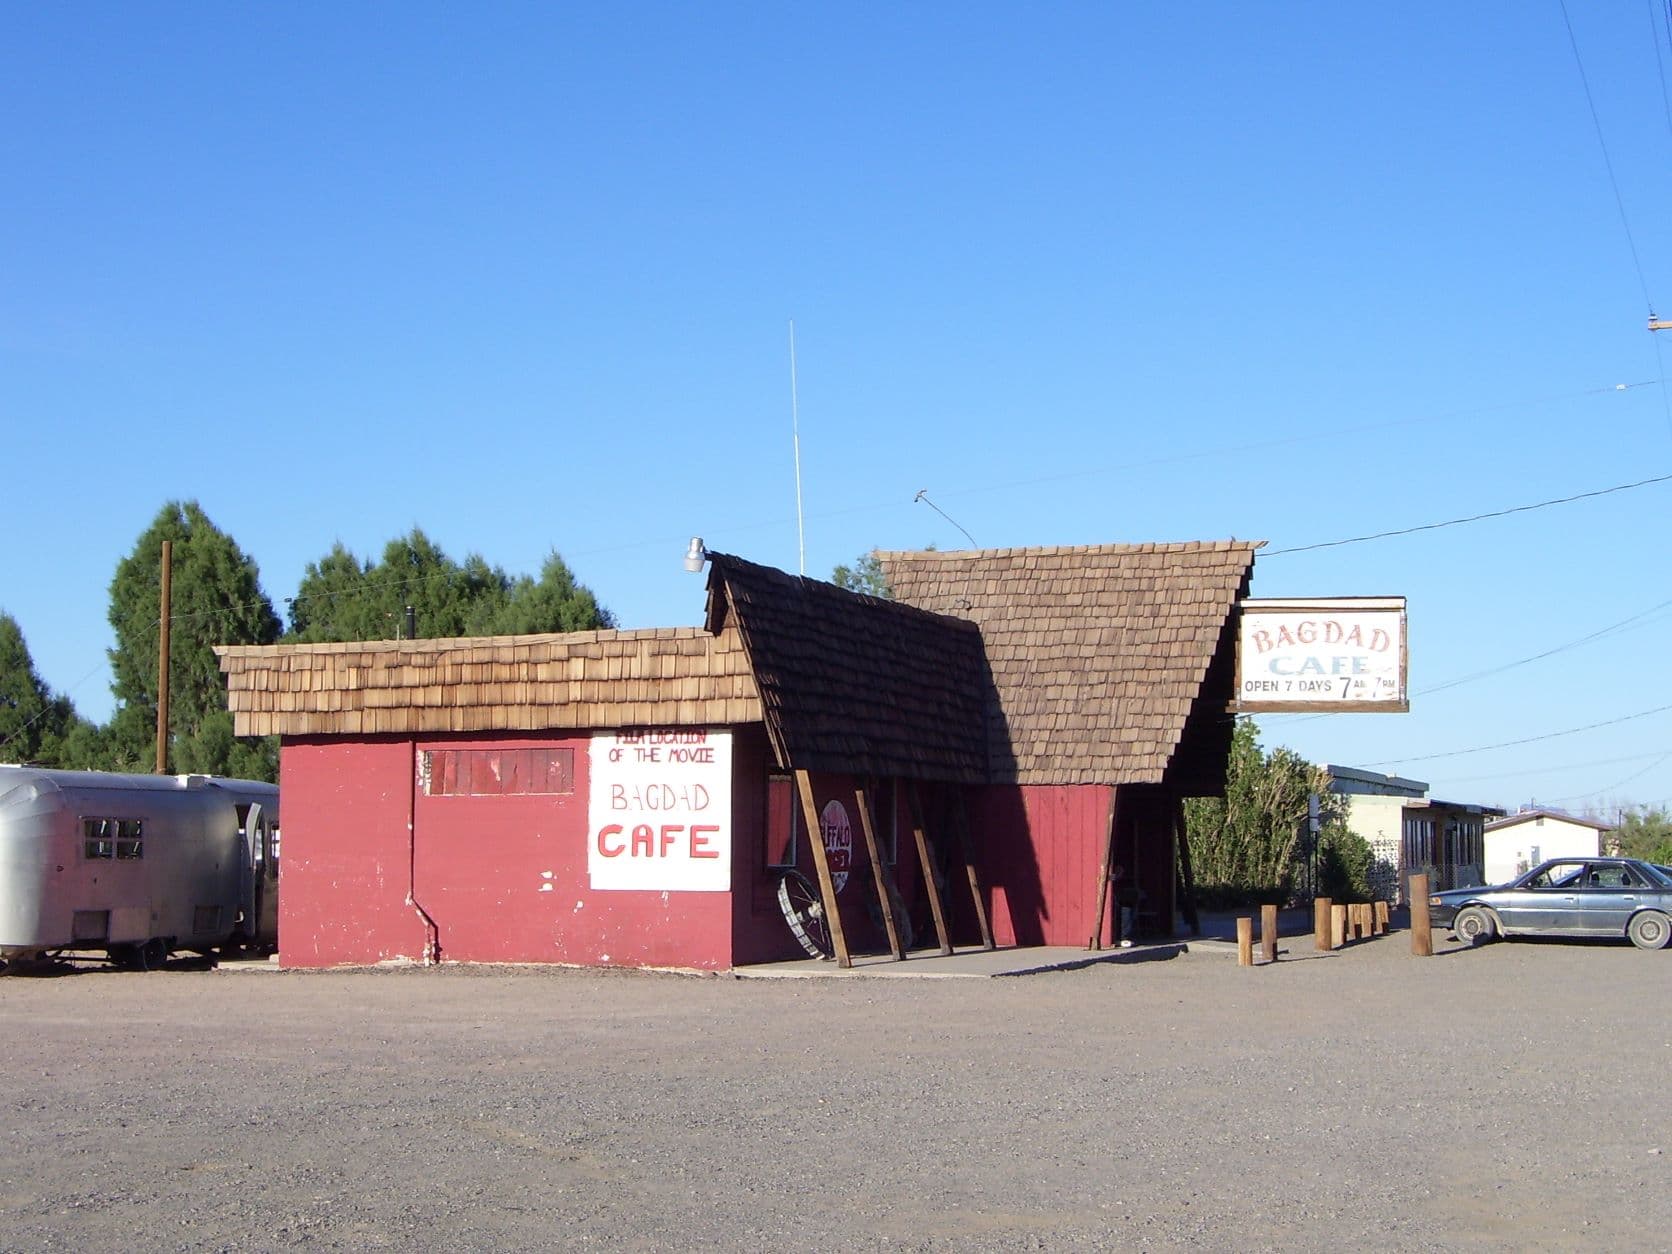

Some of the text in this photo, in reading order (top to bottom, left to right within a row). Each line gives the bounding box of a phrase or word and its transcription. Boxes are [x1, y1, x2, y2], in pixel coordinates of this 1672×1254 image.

[1251, 620, 1391, 654] BAGDAD
[1268, 656, 1370, 676] CAFE
[1245, 680, 1279, 692] OPEN
[1285, 680, 1293, 692] 7
[1298, 680, 1332, 692] DAYS
[1339, 677, 1352, 699] 7
[1382, 680, 1395, 689] PM
[649, 730, 707, 744] LOCATION
[608, 748, 715, 763] OF THE MOVIE
[611, 784, 709, 811] BAGDAD
[597, 824, 720, 858] CAFE
